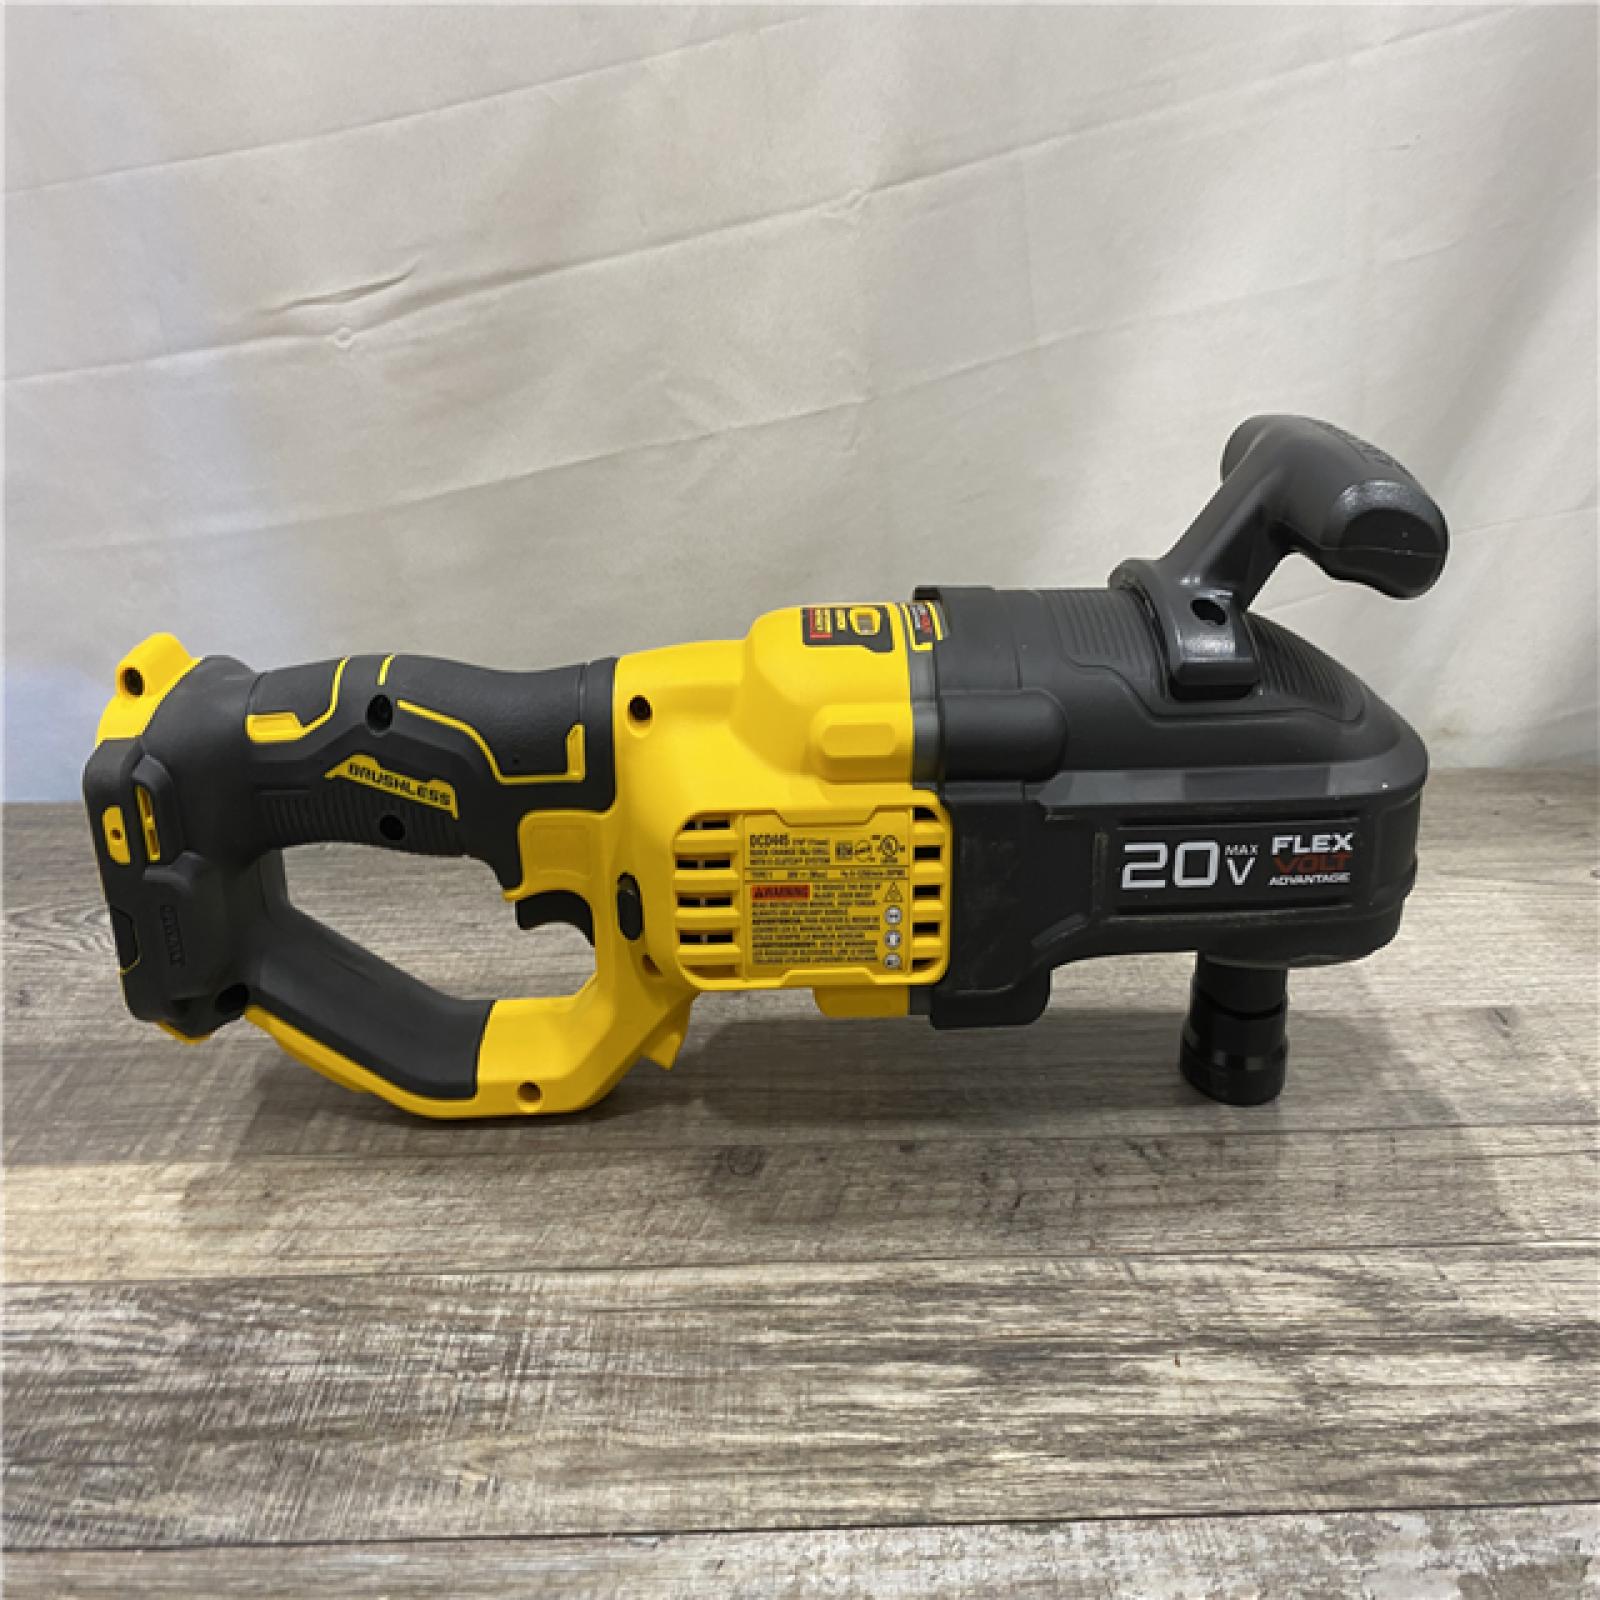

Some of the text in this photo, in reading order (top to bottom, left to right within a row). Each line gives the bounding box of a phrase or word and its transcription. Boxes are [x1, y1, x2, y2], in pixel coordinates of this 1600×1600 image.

[349, 762, 451, 806] BRUSHLESS
[1224, 844, 1259, 856] MAX
[1271, 833, 1354, 855] FLEX
[1274, 853, 1350, 873] VOLT
[1267, 871, 1351, 886] ADVANTAGE
